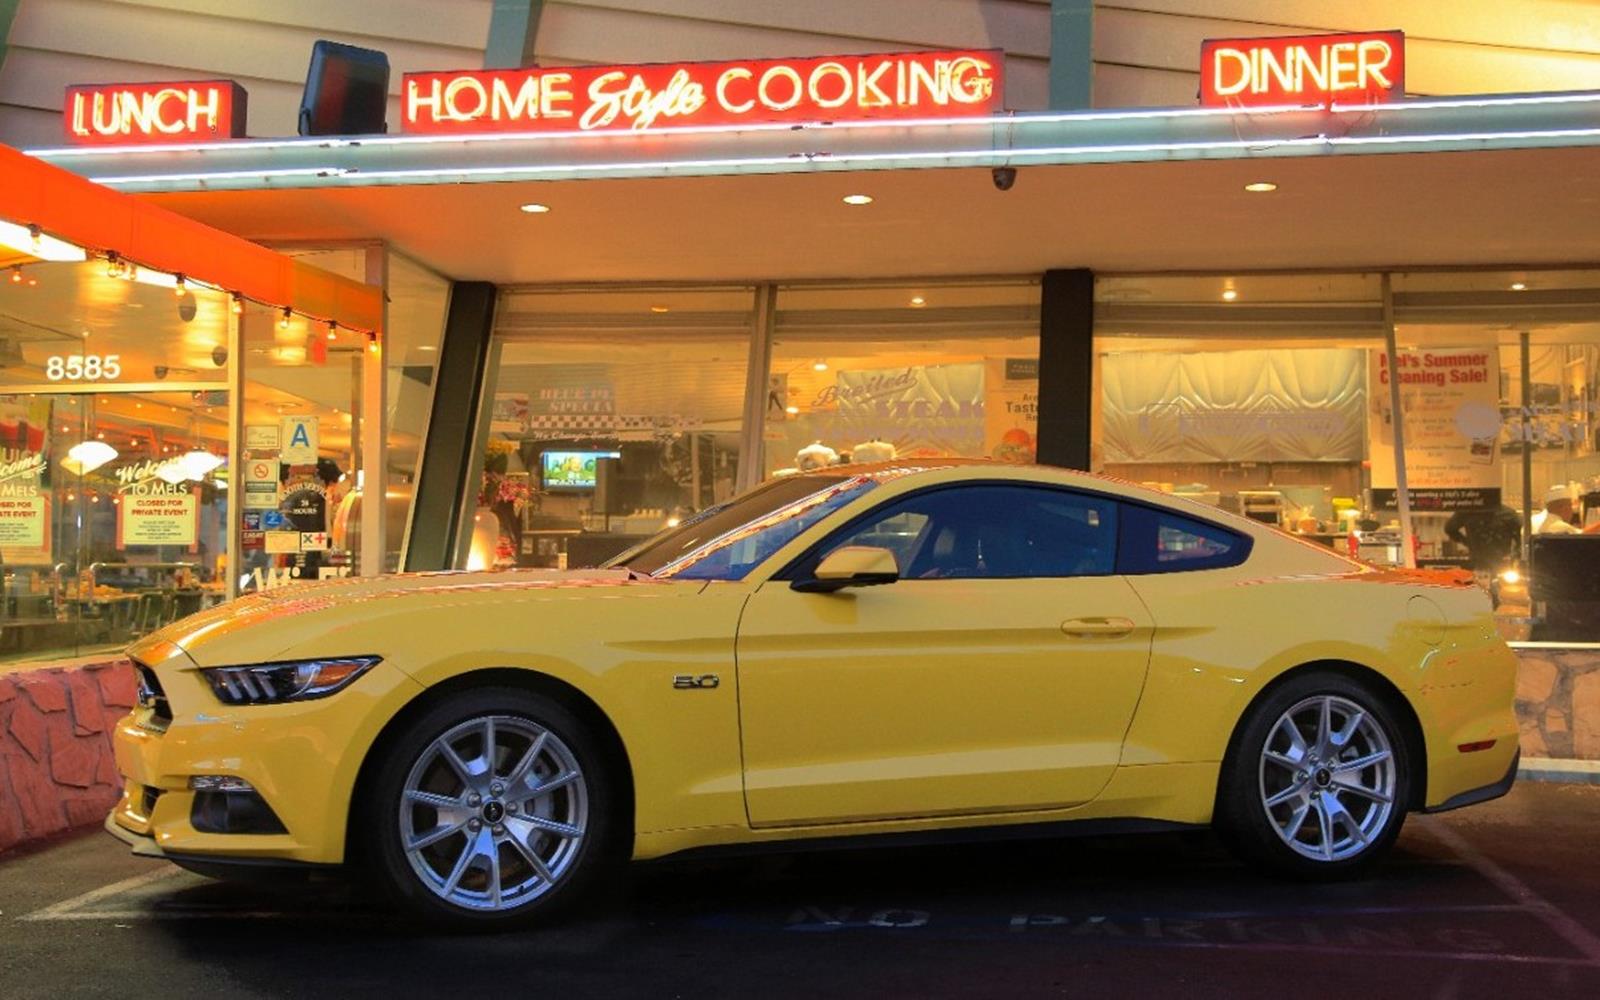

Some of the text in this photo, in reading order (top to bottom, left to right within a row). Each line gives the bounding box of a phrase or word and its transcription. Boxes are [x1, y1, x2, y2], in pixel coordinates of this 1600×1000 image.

[1214, 40, 1393, 95] DINNER
[408, 56, 993, 131] HOME Style COOKING
[73, 88, 219, 136] LUNCH
[46, 355, 121, 380] 8585
[1424, 353, 1489, 367] Summer
[1380, 368, 1488, 388] Ceaning Sale!
[290, 423, 310, 448] A
[1, 483, 37, 497] MELS
[131, 481, 188, 496] TO MELS
[132, 509, 188, 517] PRIVATE EVENT
[673, 674, 719, 689] 5.0
